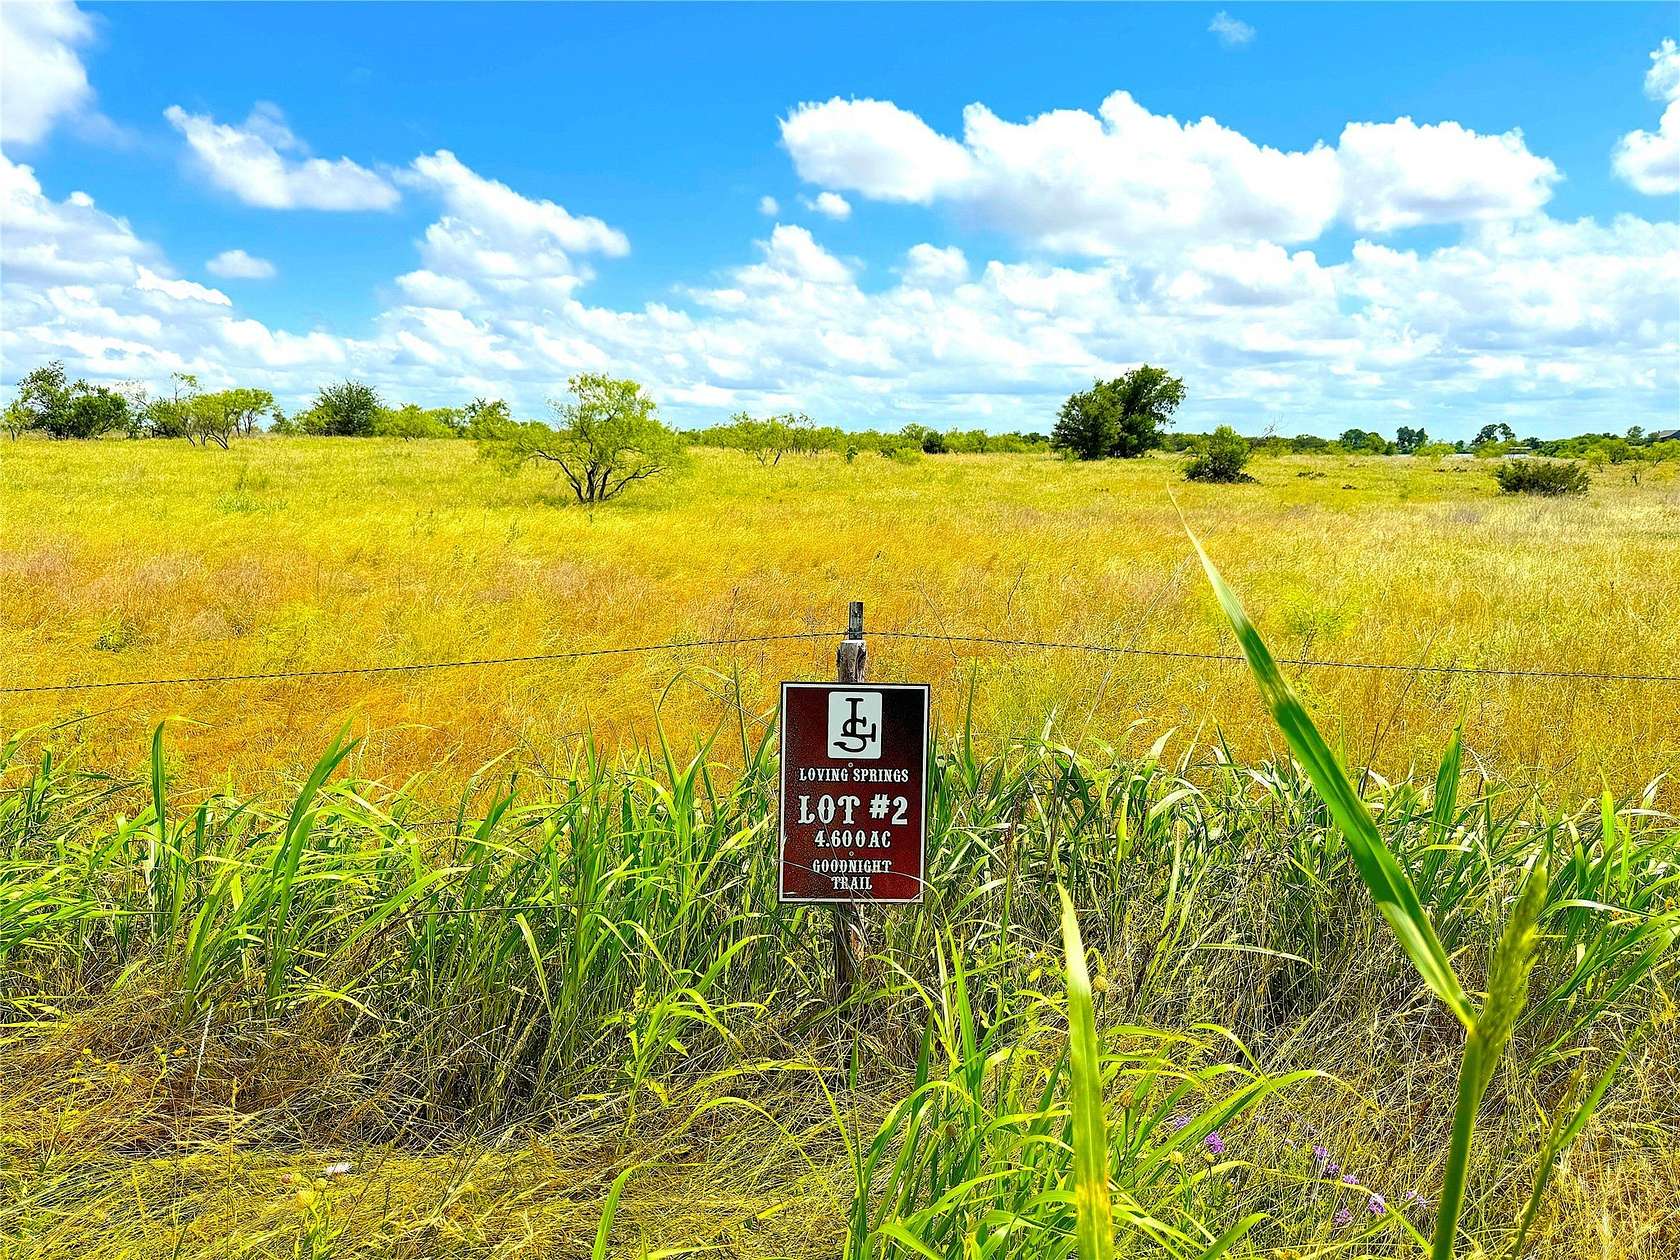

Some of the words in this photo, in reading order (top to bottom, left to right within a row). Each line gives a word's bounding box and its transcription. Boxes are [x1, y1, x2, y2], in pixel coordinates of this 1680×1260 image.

[799, 767, 848, 782] LOVING
[853, 768, 909, 783] SPRINGS
[798, 794, 861, 825] LOT
[869, 793, 908, 825] #2
[812, 859, 892, 874] GOODNIGHT
[831, 876, 872, 890] TRAIL
